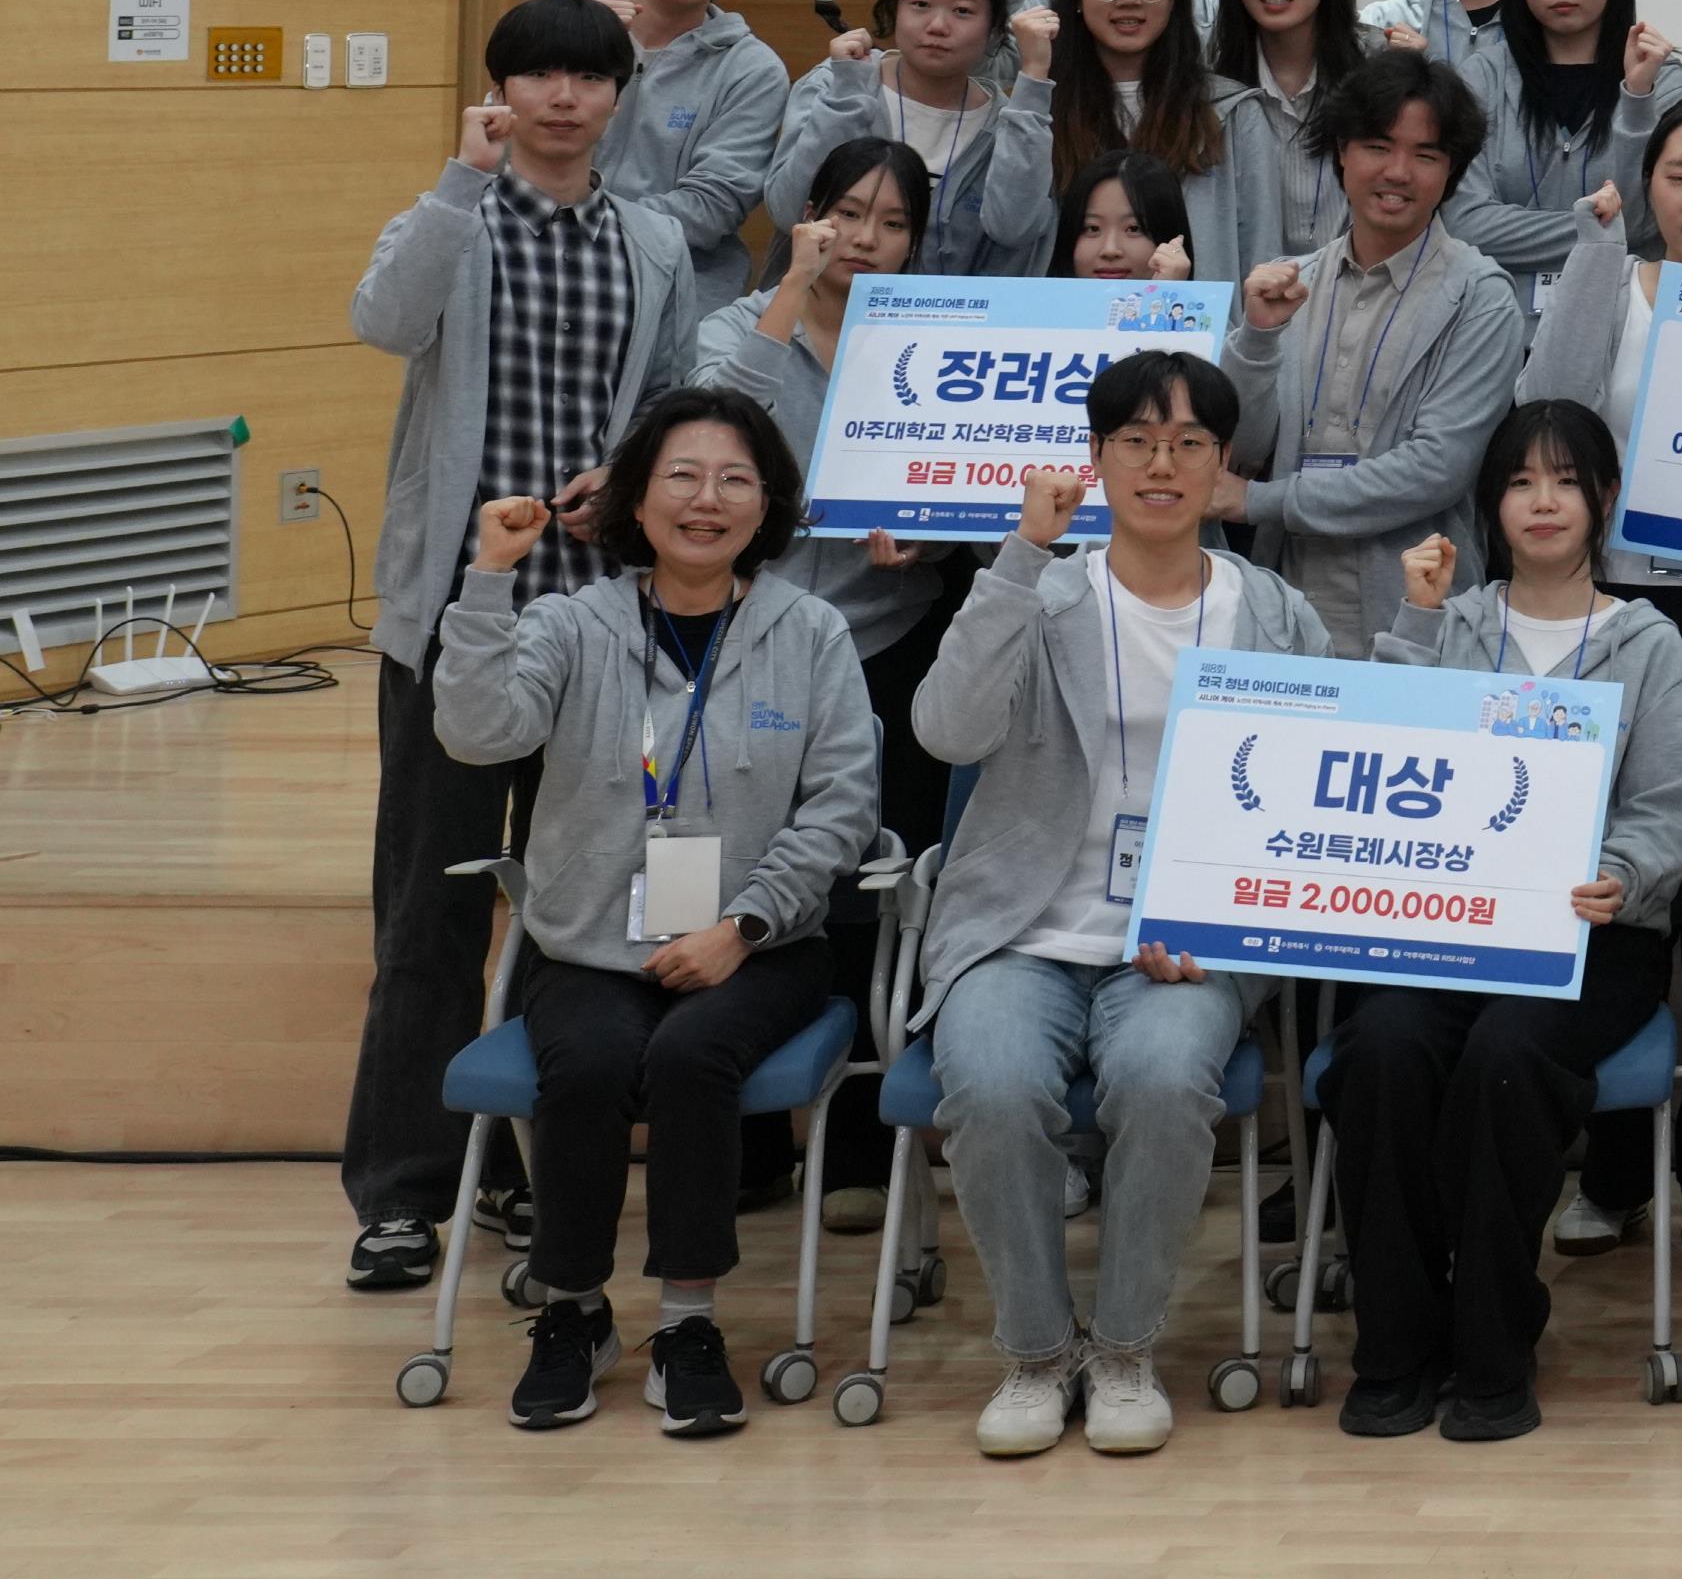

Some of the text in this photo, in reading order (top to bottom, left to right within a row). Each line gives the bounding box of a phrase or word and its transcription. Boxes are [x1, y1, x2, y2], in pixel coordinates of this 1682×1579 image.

[868, 296, 989, 310] 전국 청년 아이디어톤 대회
[844, 421, 1091, 446] 아주대학교 지산학융복합교
[906, 462, 957, 486] 일금
[1198, 675, 1339, 699] 전국 청년 아이디어톤 대회
[1313, 749, 1454, 819] 대상
[1265, 829, 1475, 872] 수원특례시장상
[1232, 876, 1497, 925] 일금 2,000,000원
